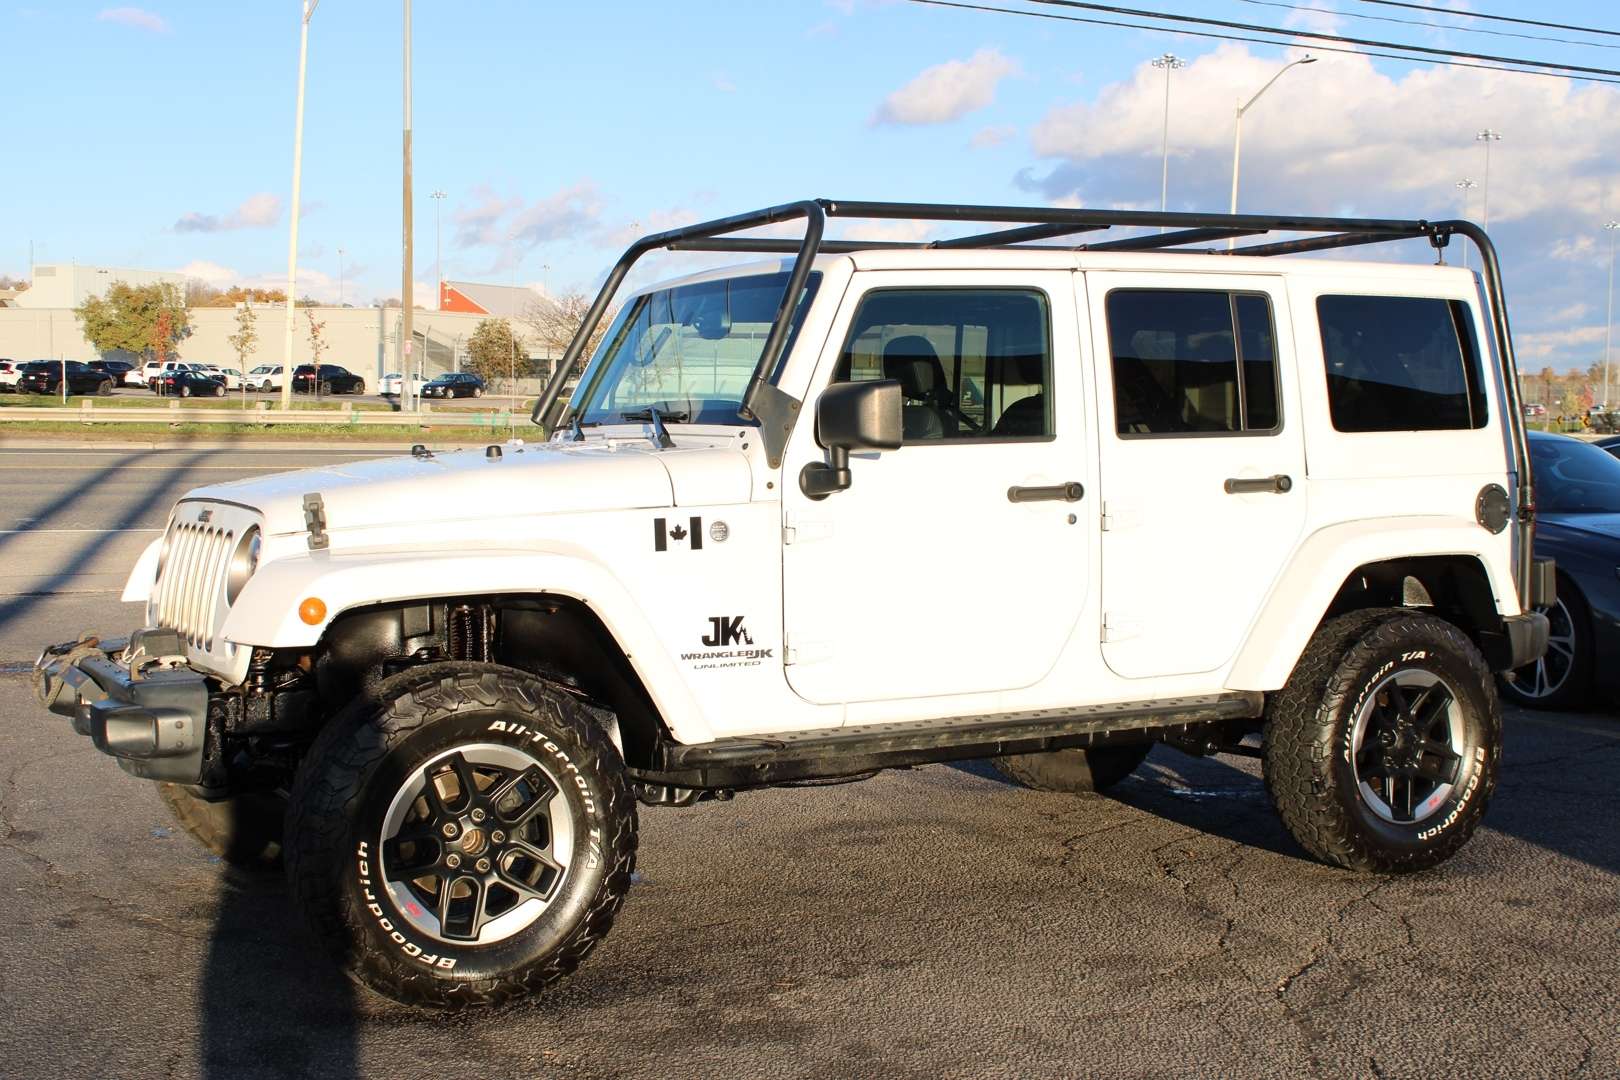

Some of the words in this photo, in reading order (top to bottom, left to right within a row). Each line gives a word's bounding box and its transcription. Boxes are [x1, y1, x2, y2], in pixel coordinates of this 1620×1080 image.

[694, 661, 761, 670] UNLIMITED
[1401, 651, 1427, 662] T/A
[487, 720, 597, 814] All-Terrain
[585, 828, 601, 870] T/A
[1417, 746, 1485, 841] BFGoodrich
[357, 841, 458, 969] BFGoodrich
